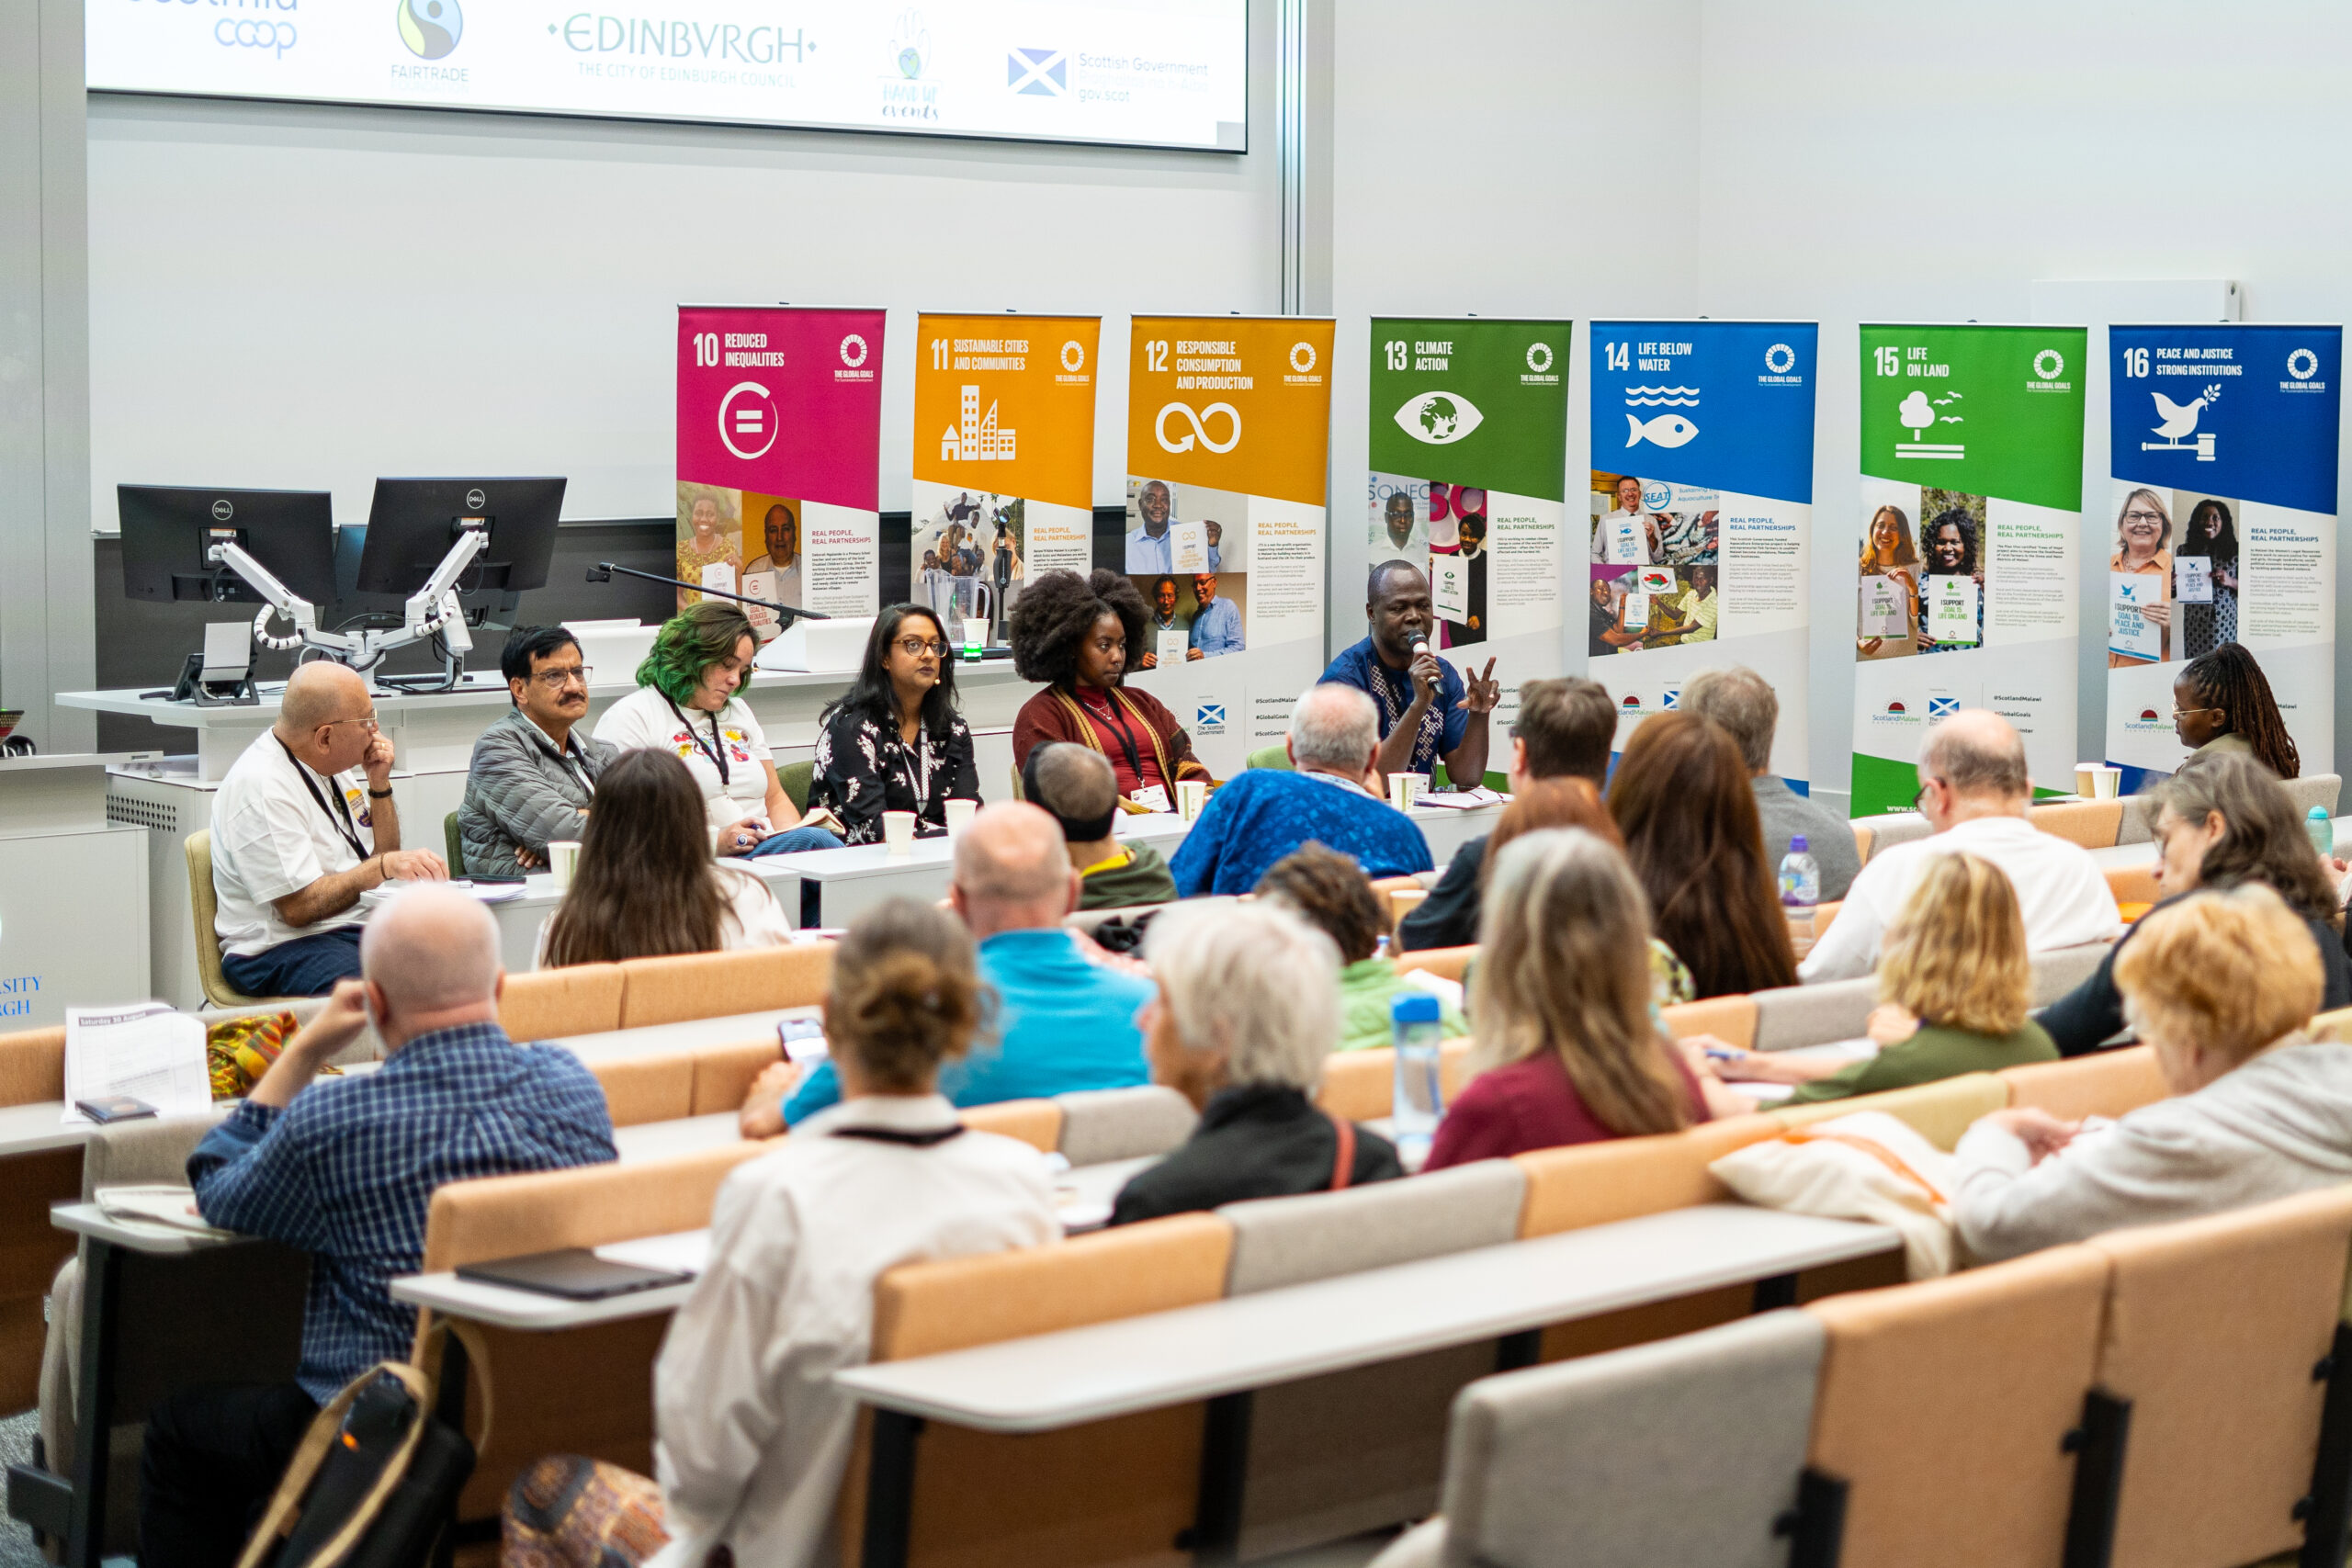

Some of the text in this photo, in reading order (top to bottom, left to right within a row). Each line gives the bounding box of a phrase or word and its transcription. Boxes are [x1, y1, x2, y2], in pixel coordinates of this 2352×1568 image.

[214, 17, 297, 60] coop
[564, 13, 804, 63] EDINBVRGH
[1080, 52, 1208, 76] Scottish Government
[391, 64, 469, 82] FAIRTRADE
[579, 62, 797, 88] THE CITY OF EDINBURGH COUNCIL
[1079, 88, 1130, 103] gov.scot
[881, 105, 939, 122] events
[693, 333, 767, 367] 10 REDUCED
[931, 338, 1029, 370] 11 SUSTAINABLE CITIES
[1145, 340, 1237, 372] 12 RESPONSIBLE
[1384, 340, 1453, 371] 13 CLIMATE
[1604, 342, 1692, 371] 14 LIFE BELOW
[725, 352, 785, 367] INEQUALITIES
[954, 357, 1025, 370] AND COMMUNITIES
[1176, 358, 1241, 373] CONSUMPTION
[1415, 357, 1448, 371] ACTION
[1638, 358, 1670, 371] WATER
[1873, 346, 1928, 377] 15 LIFE
[2123, 347, 2233, 378] 16 PEACE AND JUSTICE
[1906, 364, 1950, 378] ON LAND
[2156, 365, 2243, 376] STRONG INSTITUTIONS
[1176, 377, 1254, 389] AND PRODUCTION
[2036, 381, 2053, 389] GLOBAL
[2279, 381, 2325, 389] THE GLOBAL GOALS
[1645, 491, 1669, 501] SEAT
[2117, 603, 2142, 614] SUPPORT
[2118, 611, 2131, 620] GOAL
[2115, 617, 2144, 630] PEACE AND
[2118, 626, 2140, 637] JUSTICE
[2124, 722, 2174, 730] ScotlandMalawi
[0, 976, 42, 995] SITY
[80, 1010, 147, 1026] Saturday 30 August
